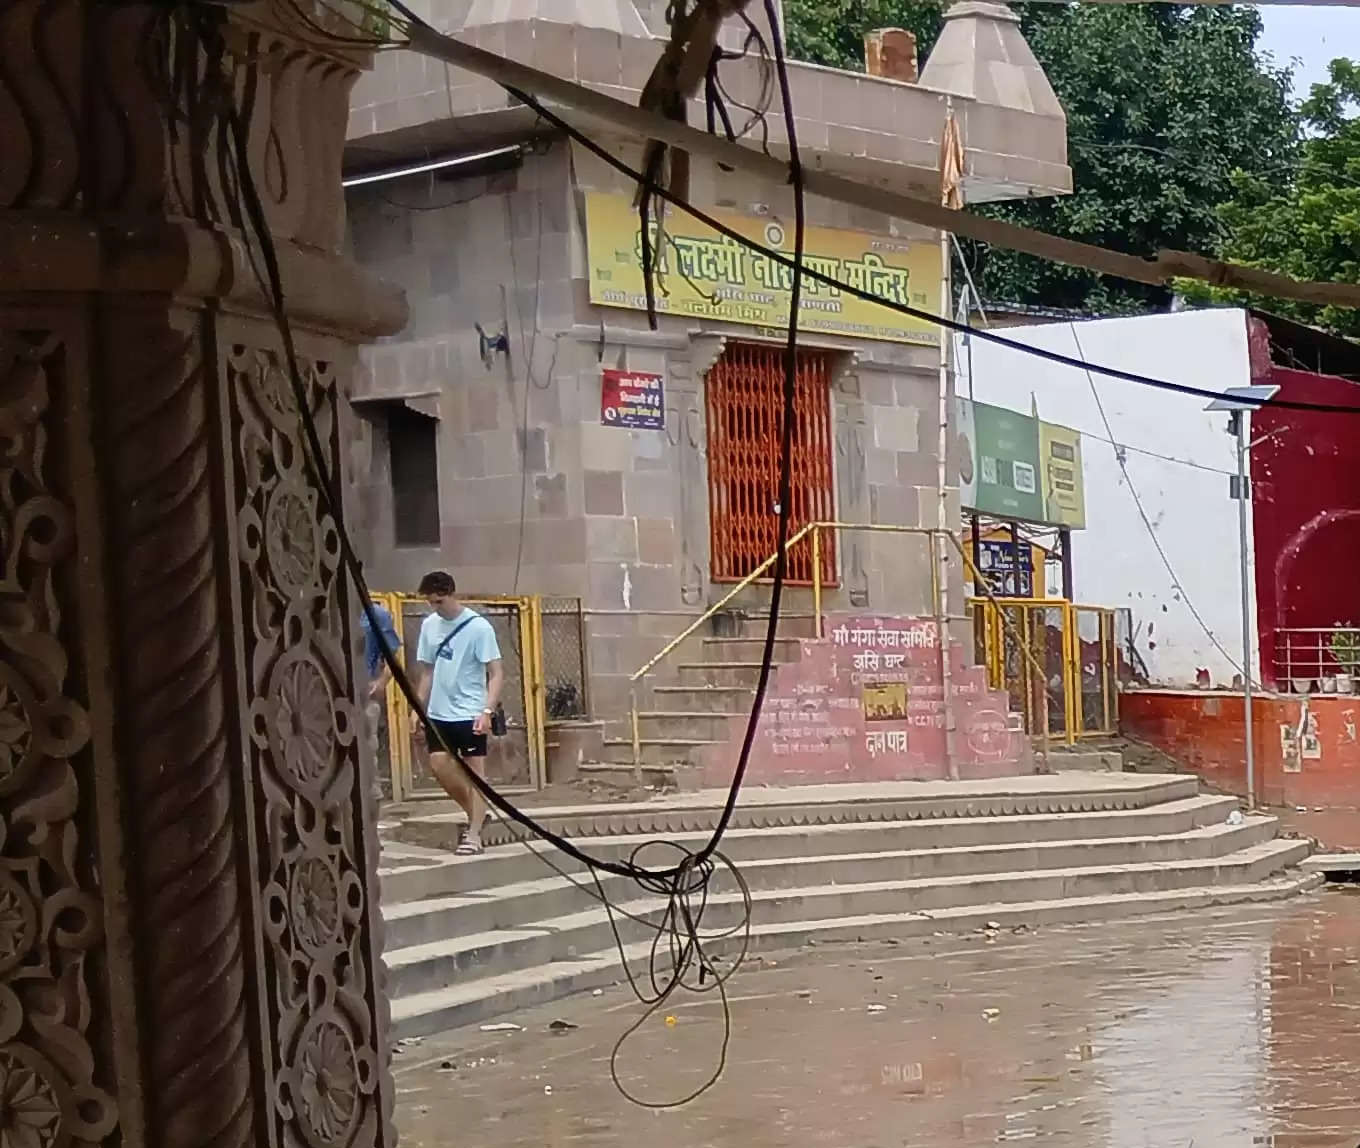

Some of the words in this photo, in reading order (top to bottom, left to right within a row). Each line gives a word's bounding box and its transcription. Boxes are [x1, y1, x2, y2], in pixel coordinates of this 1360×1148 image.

[750, 248, 841, 299] नारयण
[844, 252, 909, 306] मन्दिर
[850, 628, 876, 648] गंगा
